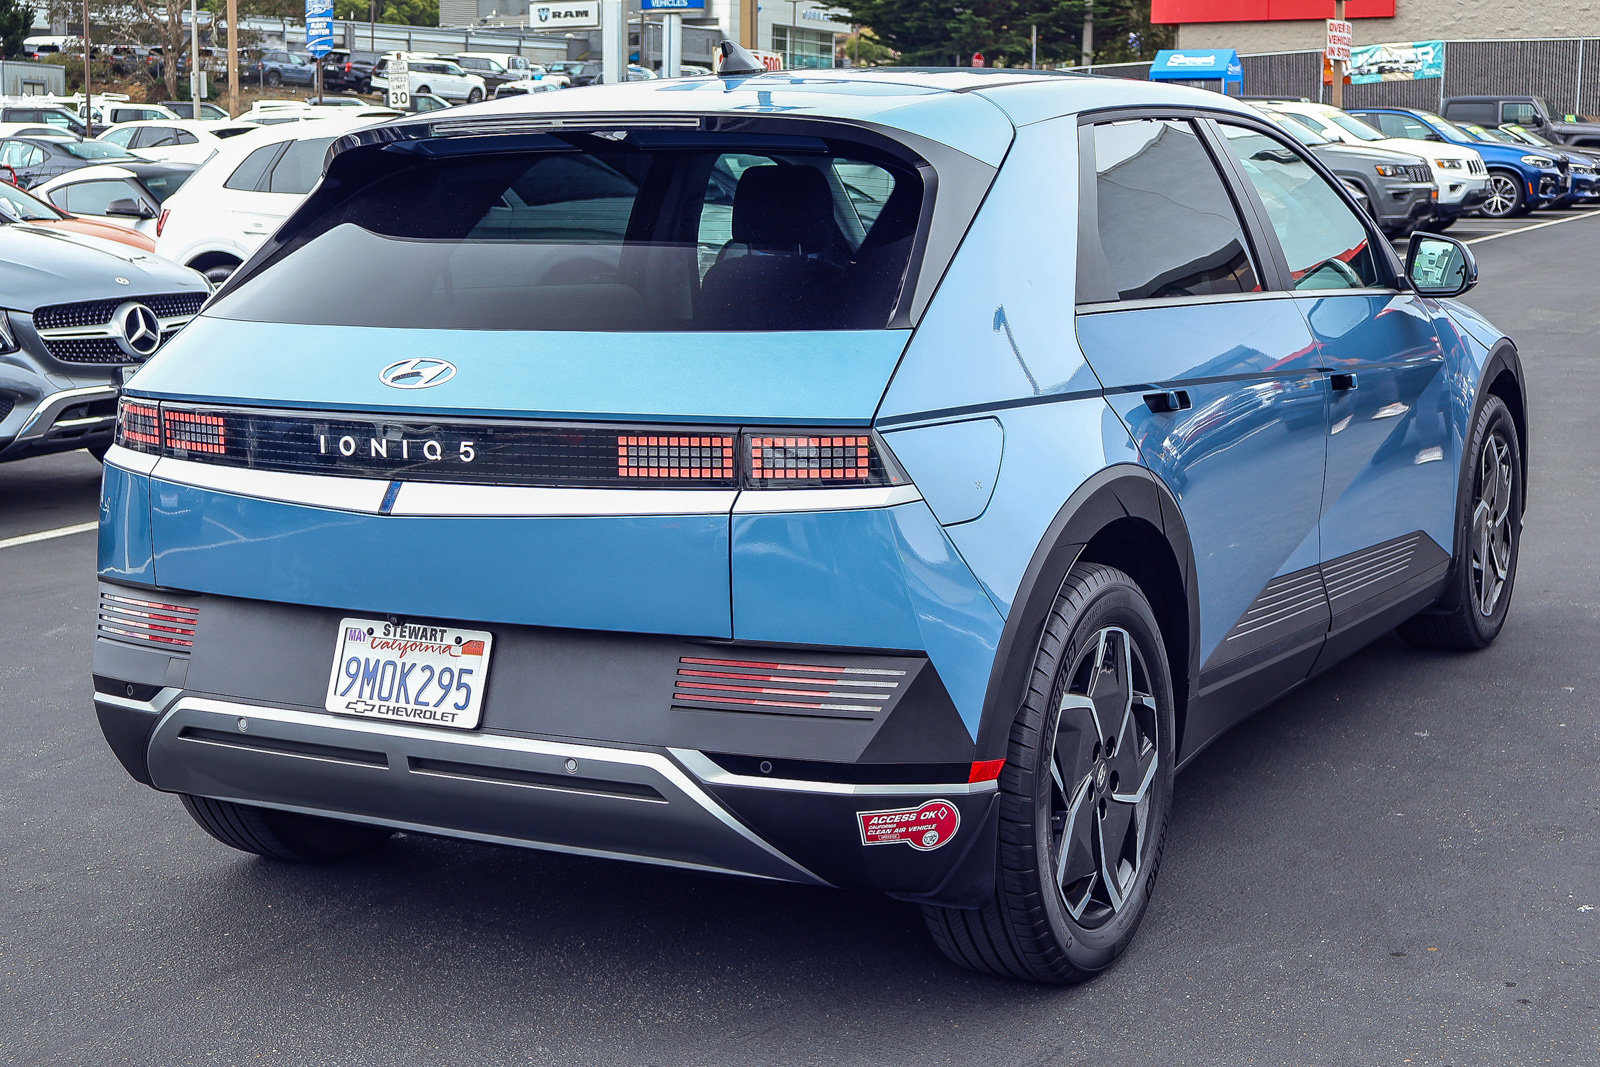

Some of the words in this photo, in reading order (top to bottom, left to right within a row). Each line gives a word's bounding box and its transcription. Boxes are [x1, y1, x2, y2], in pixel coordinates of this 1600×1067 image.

[552, 9, 589, 19] RAM
[1328, 47, 1335, 56] IN
[391, 91, 408, 104] 30
[320, 435, 443, 461] IONIQ
[459, 441, 475, 462] 5
[348, 629, 367, 642] MAY
[383, 624, 447, 642] STEWART
[371, 637, 462, 658] California
[340, 656, 473, 711] 9MOK295
[378, 704, 458, 723] CHEVROLET
[870, 814, 917, 825] ACCESS
[920, 811, 937, 820] OK
[867, 828, 893, 836] CLEAN
[908, 824, 937, 832] VEHICLE
